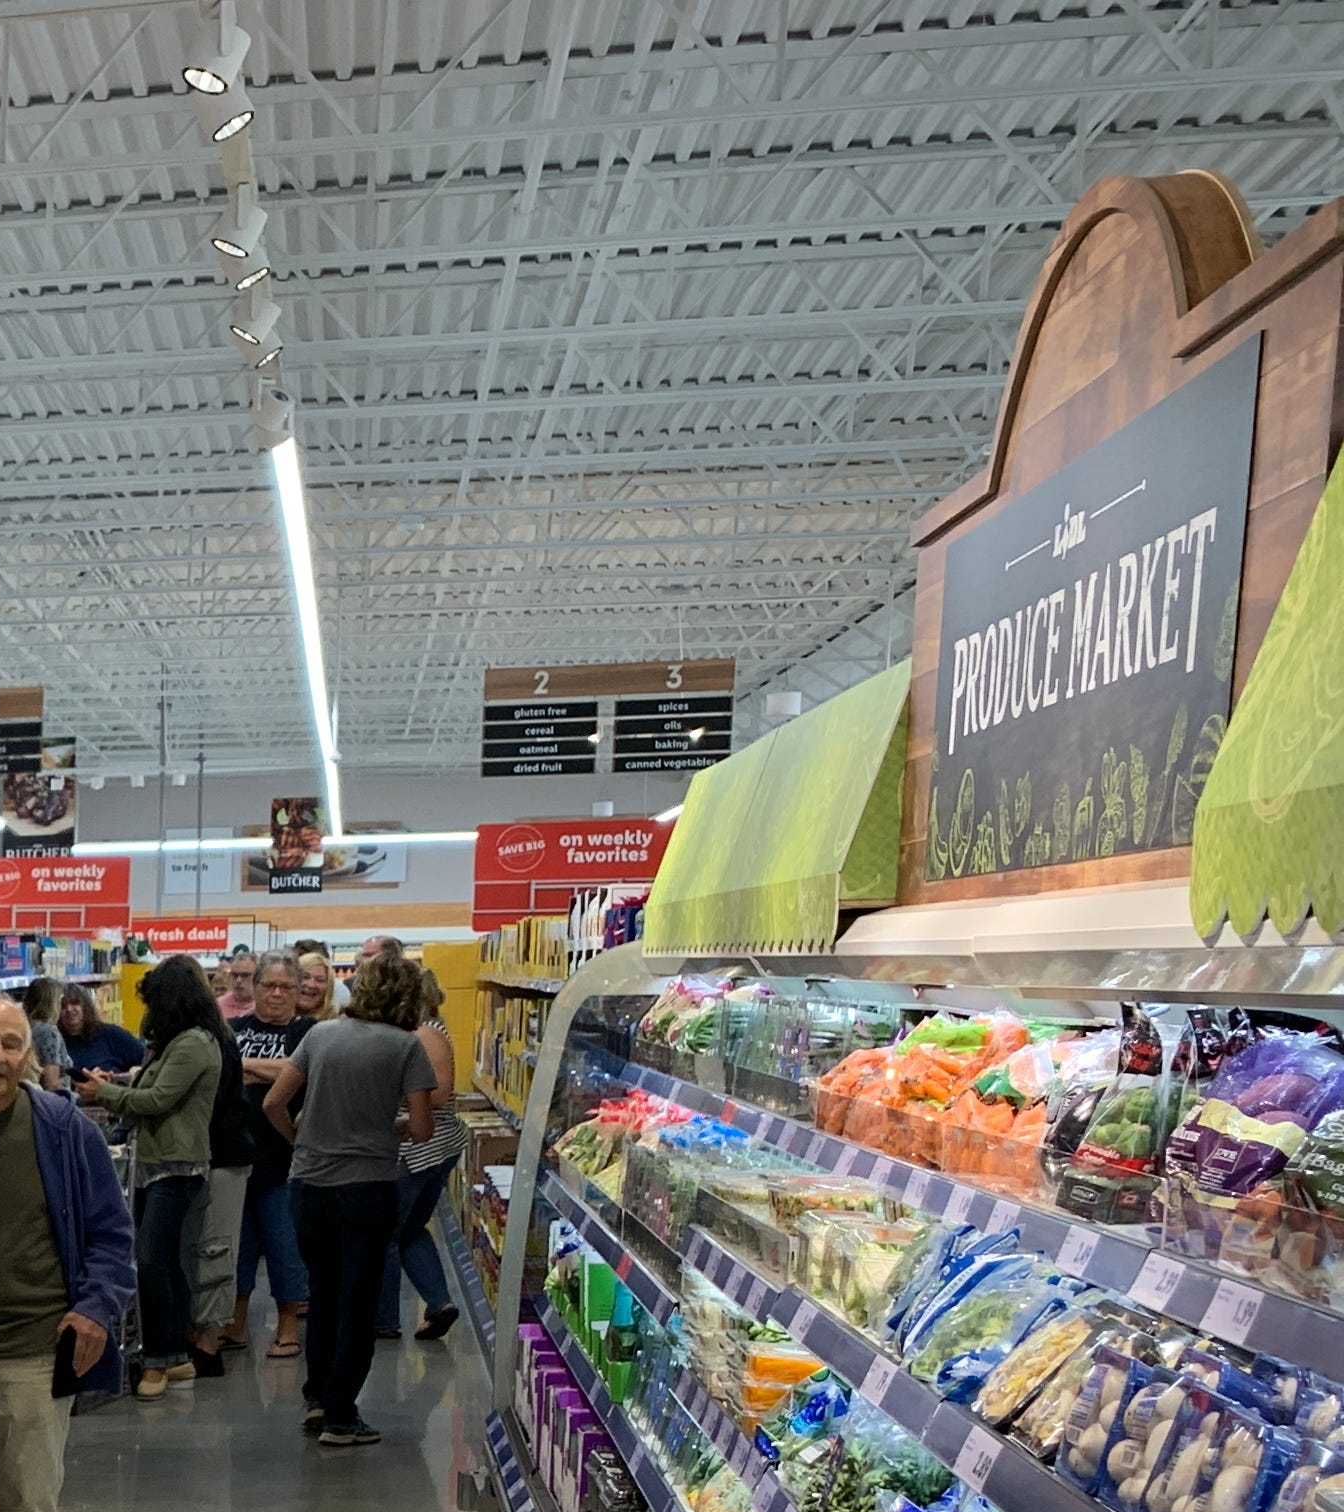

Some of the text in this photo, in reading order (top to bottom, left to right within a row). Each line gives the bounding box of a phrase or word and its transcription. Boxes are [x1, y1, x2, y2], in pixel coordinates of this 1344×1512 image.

[948, 506, 1218, 755] PRODUCE MARKET
[533, 671, 550, 695] 2
[666, 665, 683, 689] 3
[514, 707, 567, 719] gluten free
[658, 702, 689, 713] spices
[524, 726, 554, 735] cereal
[664, 721, 682, 730] oils
[519, 745, 558, 754] oatmeal
[655, 740, 689, 751] baking
[513, 763, 562, 773] dried fruit
[625, 758, 661, 769] canned
[559, 830, 653, 848] on weekly
[497, 839, 546, 858] SAVE BIG
[566, 846, 649, 864] favorites
[31, 864, 105, 880] on weekly
[184, 863, 209, 873] freh
[36, 878, 102, 893] favorites
[271, 875, 321, 889] BUTCHER
[147, 928, 187, 942] fresh
[191, 926, 227, 941] deals
